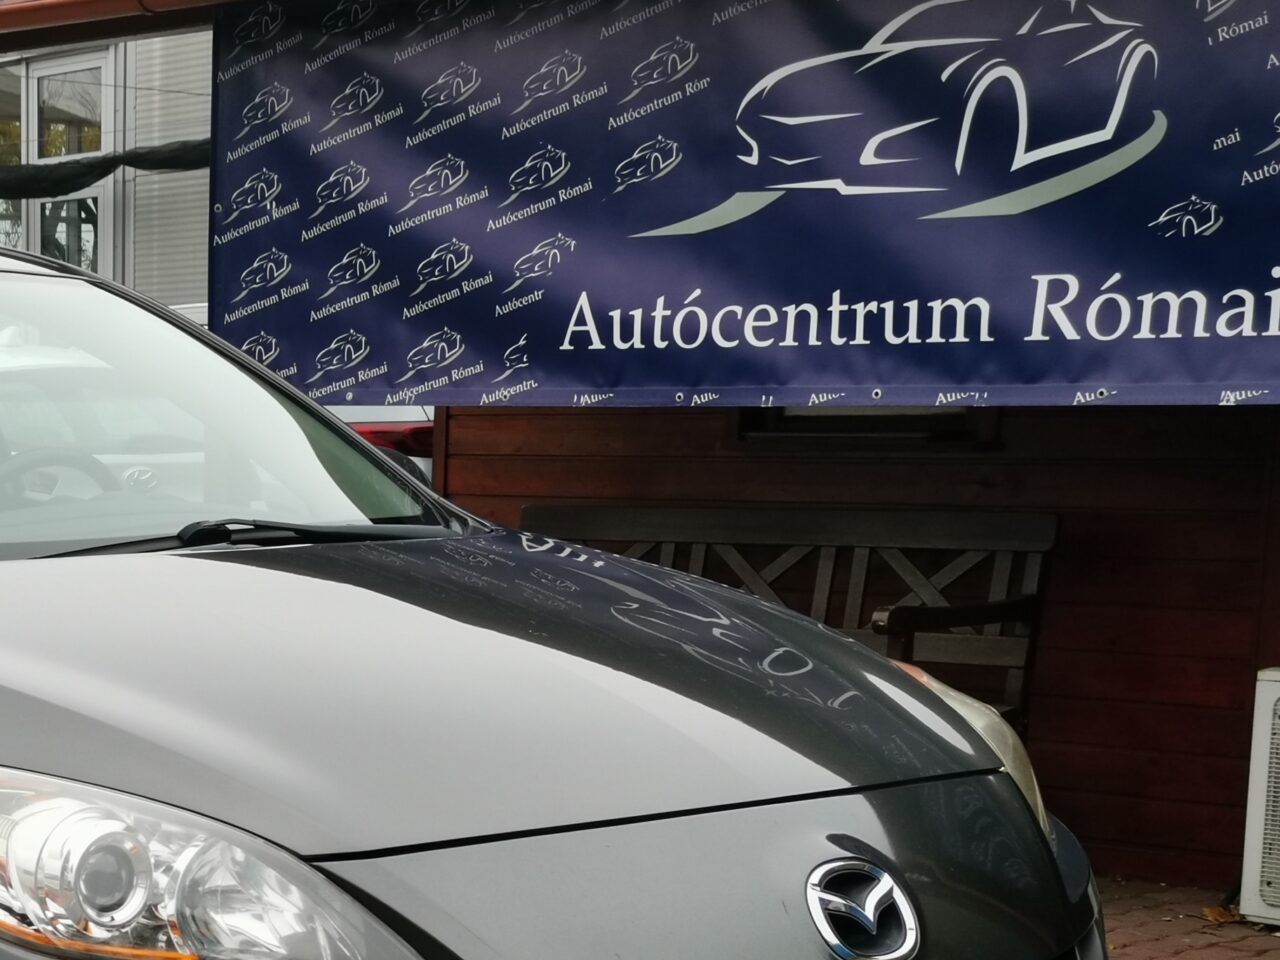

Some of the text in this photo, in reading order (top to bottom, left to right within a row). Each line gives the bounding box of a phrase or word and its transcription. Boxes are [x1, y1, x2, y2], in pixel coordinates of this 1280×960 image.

[393, 8, 496, 64] Autócentrum Római
[494, 0, 600, 53] Autócentrum Róm
[600, 0, 673, 40] Autócentrum
[1218, 10, 1269, 42] Római
[217, 32, 304, 83] Autócentrum Római
[304, 20, 396, 75] Autócentrum Római
[309, 103, 405, 156] Autócentrum Római
[405, 92, 502, 149] Autócentrum Római
[501, 81, 609, 140] Autócentrum Római
[607, 89, 683, 131] Autócentrum
[226, 111, 311, 163] Autócentrum Római
[1241, 160, 1280, 186] Autó
[301, 191, 388, 242] Autócentrum Római
[388, 186, 489, 237] Autócentrum Római
[486, 177, 593, 232] Autócentrum Római
[213, 214, 270, 247] Autócentrum
[223, 278, 310, 325] Autócentrum Római
[309, 275, 400, 323] Autócentrum Római
[402, 270, 493, 320] Autócentrum Római
[559, 266, 1280, 351] Autócentrum Római
[308, 361, 388, 399] tócentrum Római
[451, 360, 484, 382] Római
